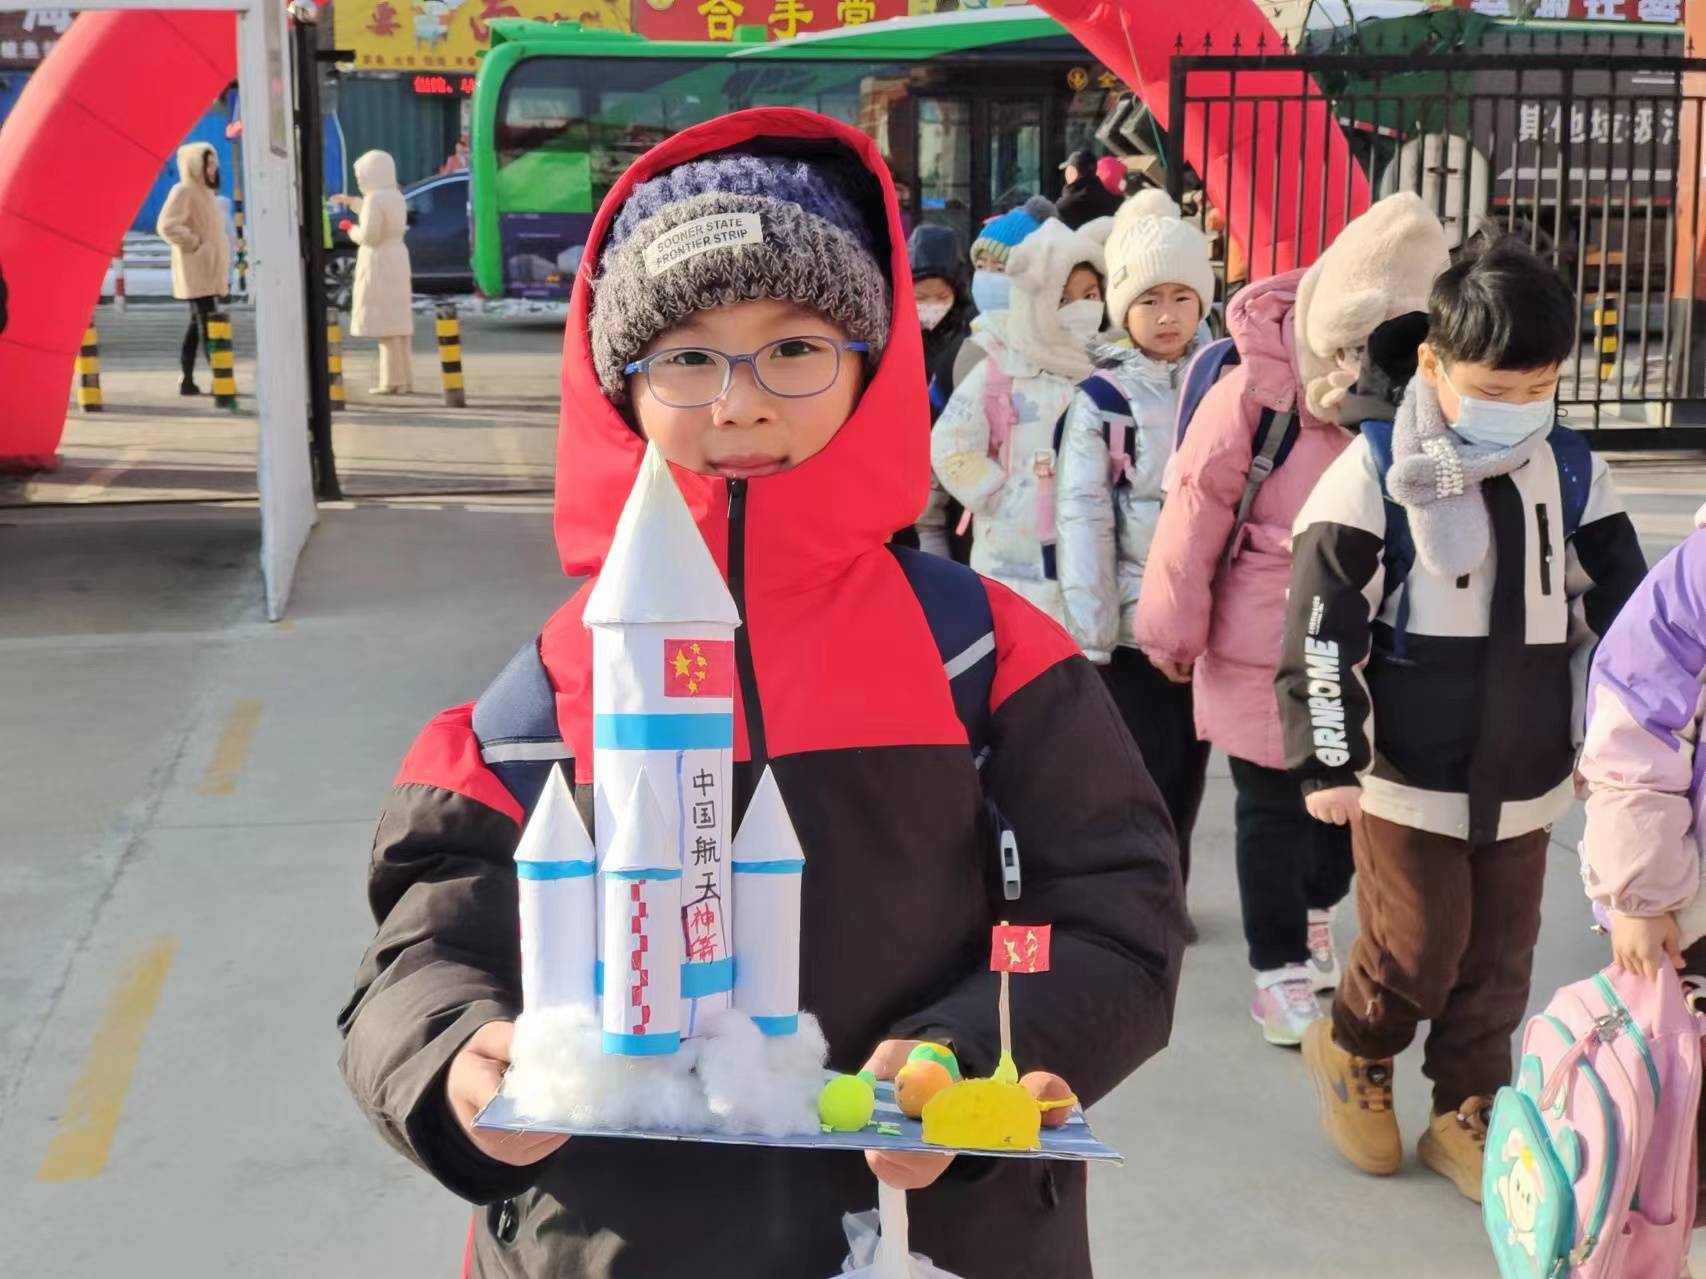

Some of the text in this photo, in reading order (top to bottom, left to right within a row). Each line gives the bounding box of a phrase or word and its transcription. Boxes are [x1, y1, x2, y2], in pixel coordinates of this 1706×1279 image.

[656, 228, 748, 267] FRONTIER STRIP
[657, 218, 743, 254] SOONER STATE
